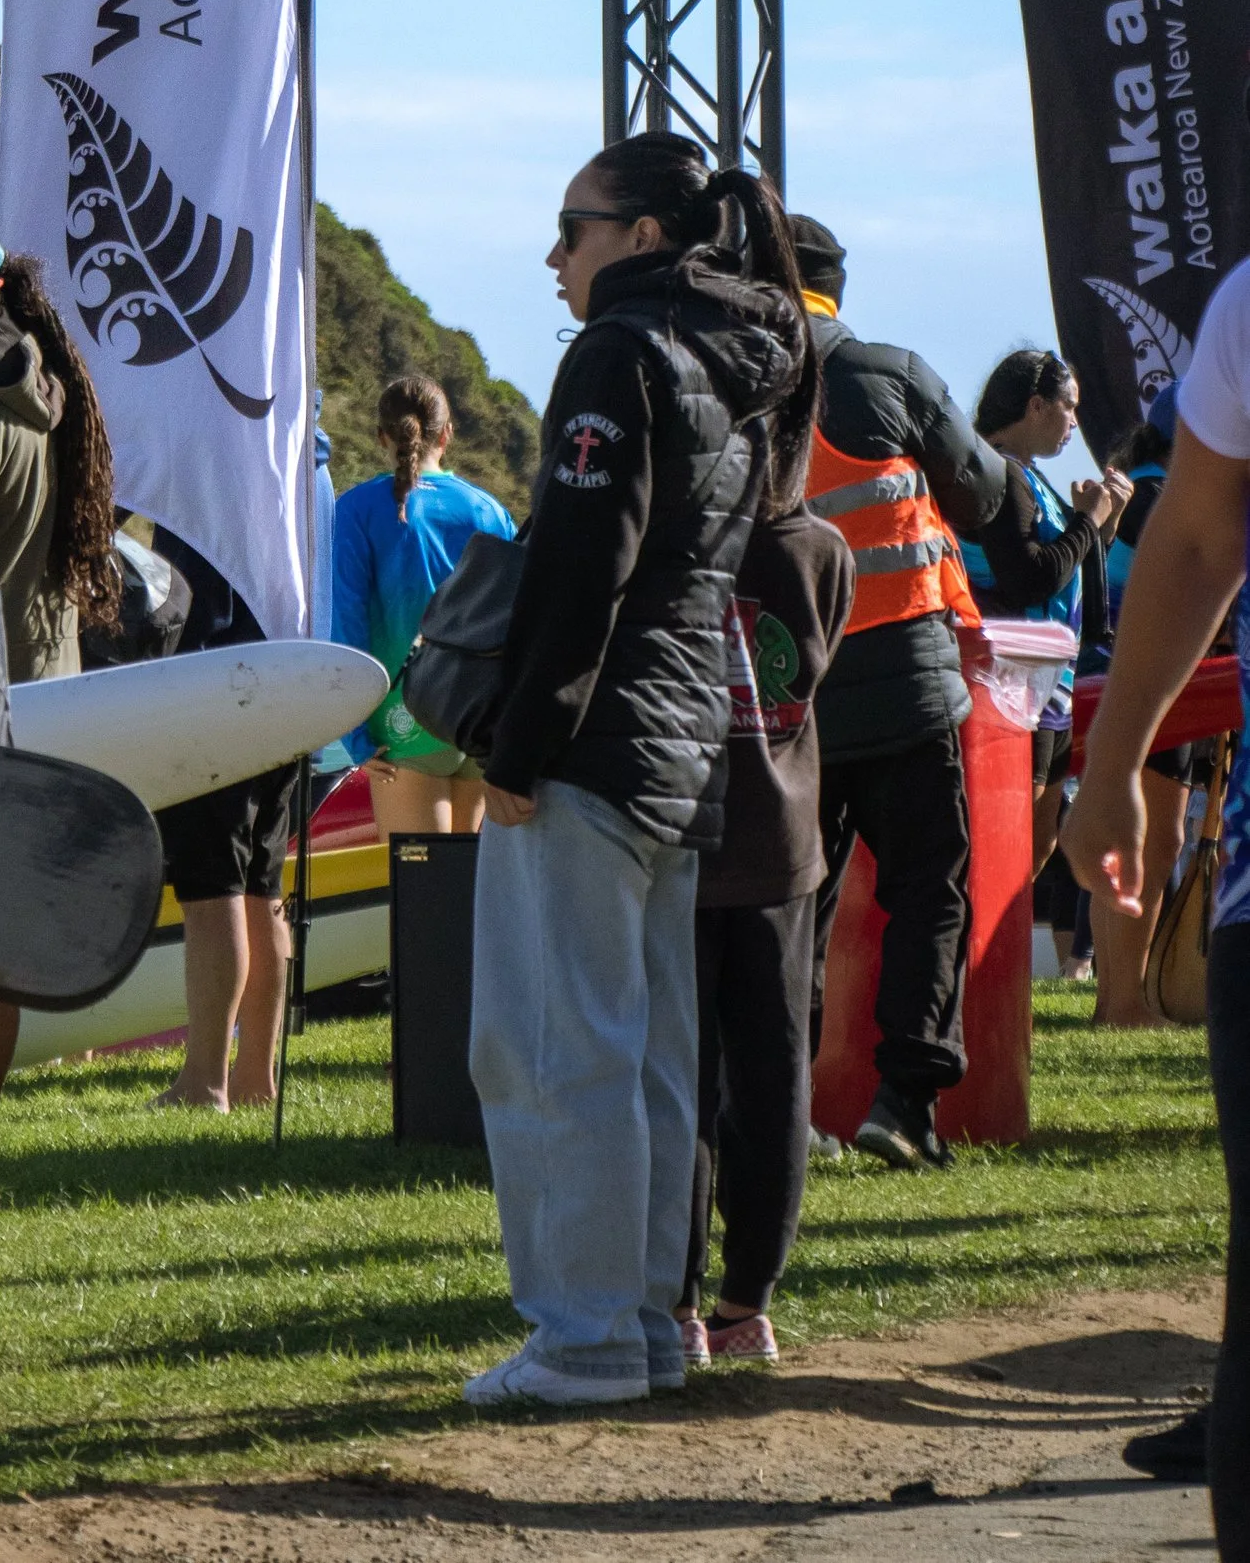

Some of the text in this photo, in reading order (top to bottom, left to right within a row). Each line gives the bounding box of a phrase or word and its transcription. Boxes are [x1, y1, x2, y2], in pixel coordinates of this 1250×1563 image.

[1165, 20, 1193, 99] New
[1109, 63, 1174, 286] waka
[1176, 109, 1216, 270] Aotearoa
